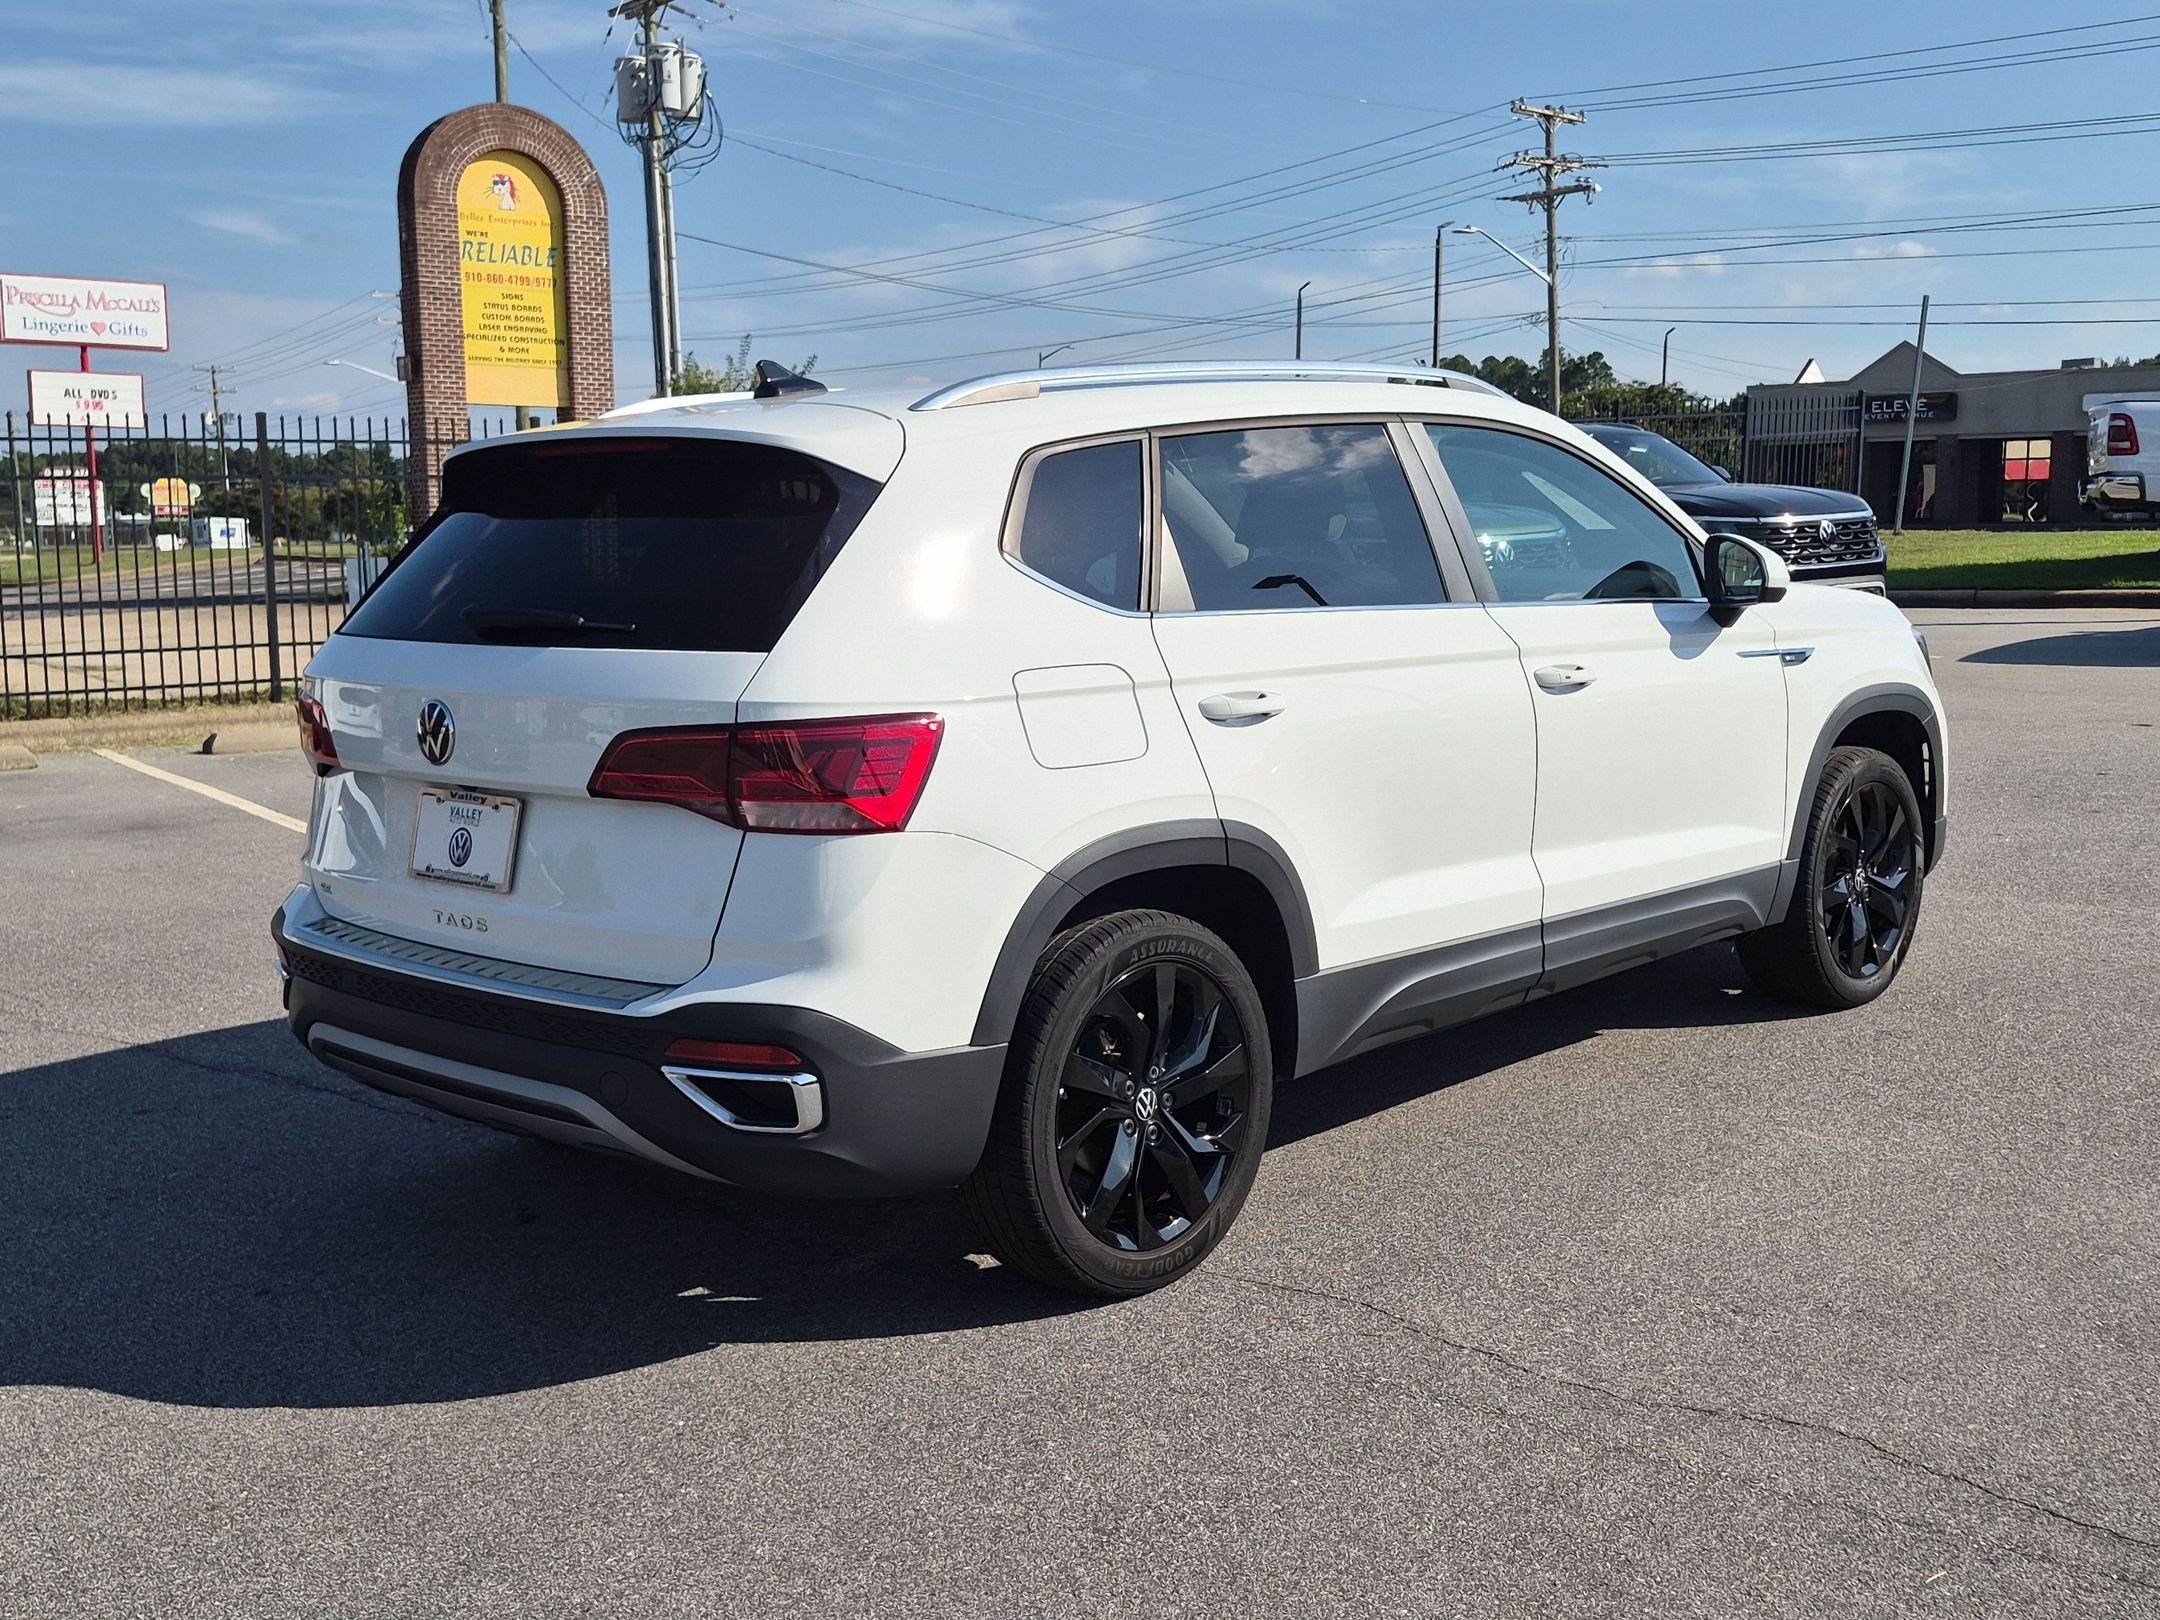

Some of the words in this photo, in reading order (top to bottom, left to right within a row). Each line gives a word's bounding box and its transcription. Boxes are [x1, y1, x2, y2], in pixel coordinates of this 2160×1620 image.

[466, 230, 489, 238] WE'RE
[461, 240, 560, 268] RELIABLE
[6, 285, 81, 317] PRISCILLA
[501, 292, 524, 301] SIGNS
[483, 302, 509, 311] STATUS
[511, 305, 543, 314] BOARDS
[481, 312, 512, 322] CUSTOM
[514, 315, 545, 324] BOARDS
[22, 317, 89, 336] Lingerie
[109, 321, 149, 338] Gifts
[478, 323, 501, 332] LASER
[503, 325, 548, 335] ENGRAVING
[463, 333, 507, 343] SPECIALIZED
[509, 336, 565, 347] CONSTRUCTION
[508, 346, 530, 355] MORE
[64, 388, 83, 400] ALL
[1864, 412, 1896, 420] EVENT
[1901, 411, 1934, 420] VNUE
[449, 791, 488, 805] Valley
[450, 805, 484, 821] VALLEY
[432, 908, 489, 934] TAOS
[1129, 939, 1214, 964] ASSURANCE
